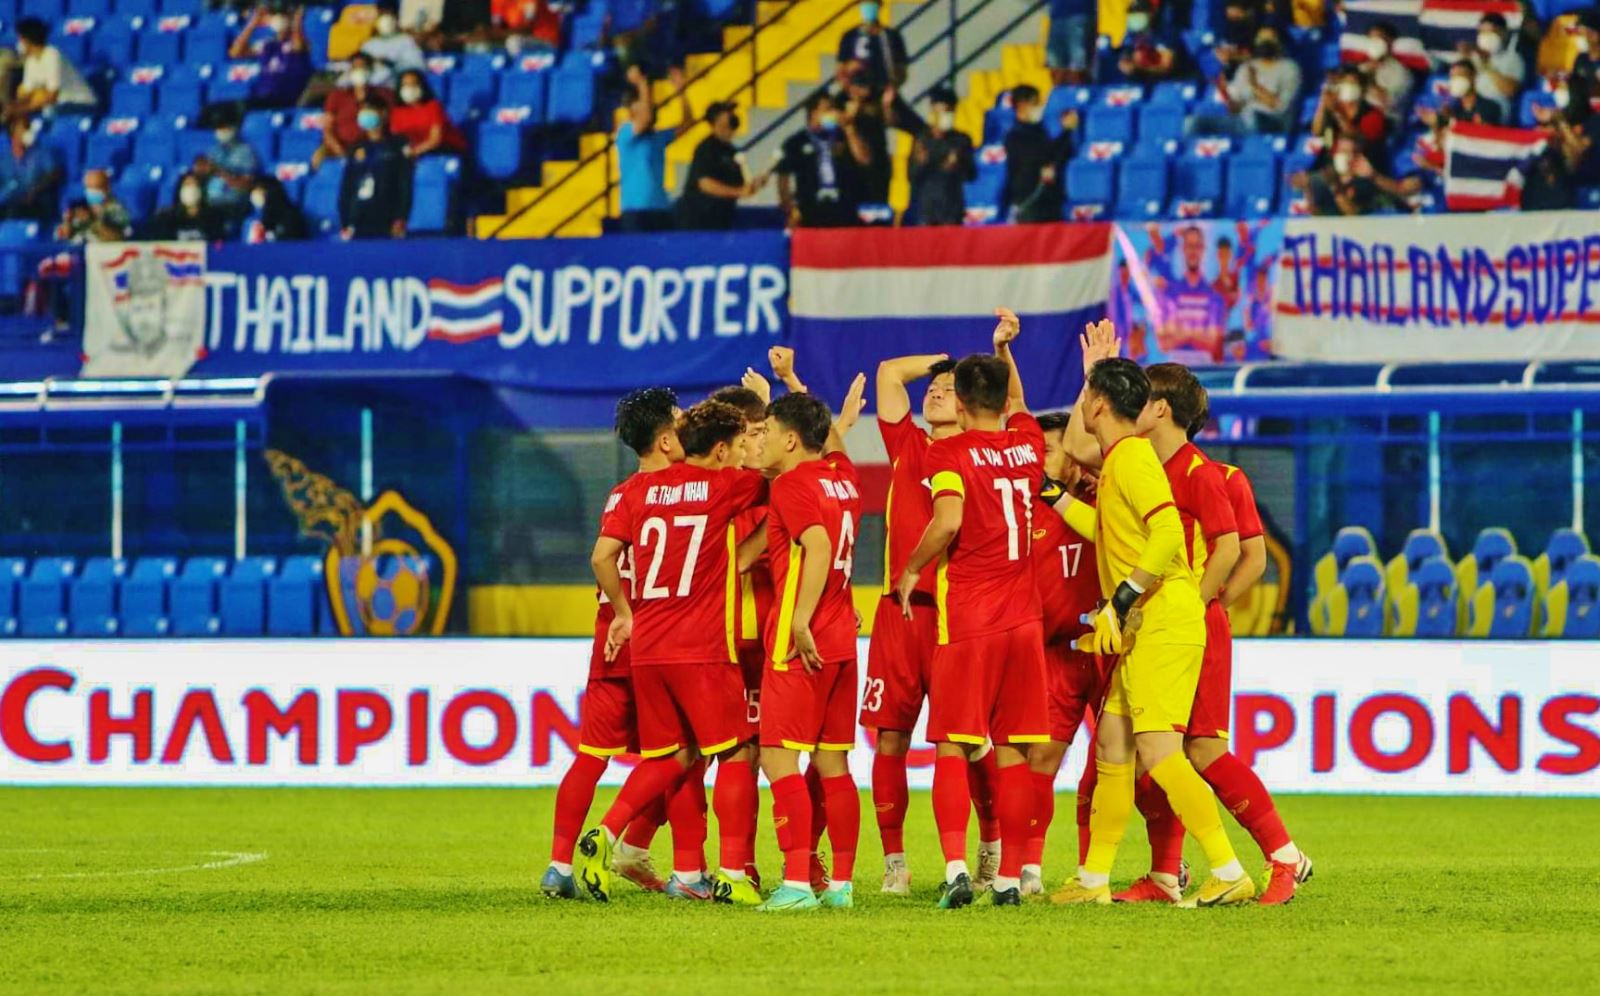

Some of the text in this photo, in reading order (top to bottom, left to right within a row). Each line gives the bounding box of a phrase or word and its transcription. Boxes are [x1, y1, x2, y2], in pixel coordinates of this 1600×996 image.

[205, 264, 786, 353] THAILAND SUPPORTER
[1003, 443, 1038, 468] TUNG
[639, 514, 708, 600] 27
[1058, 542, 1083, 578] 17
[0, 667, 642, 767] CHAMPION
[862, 676, 885, 712] 23
